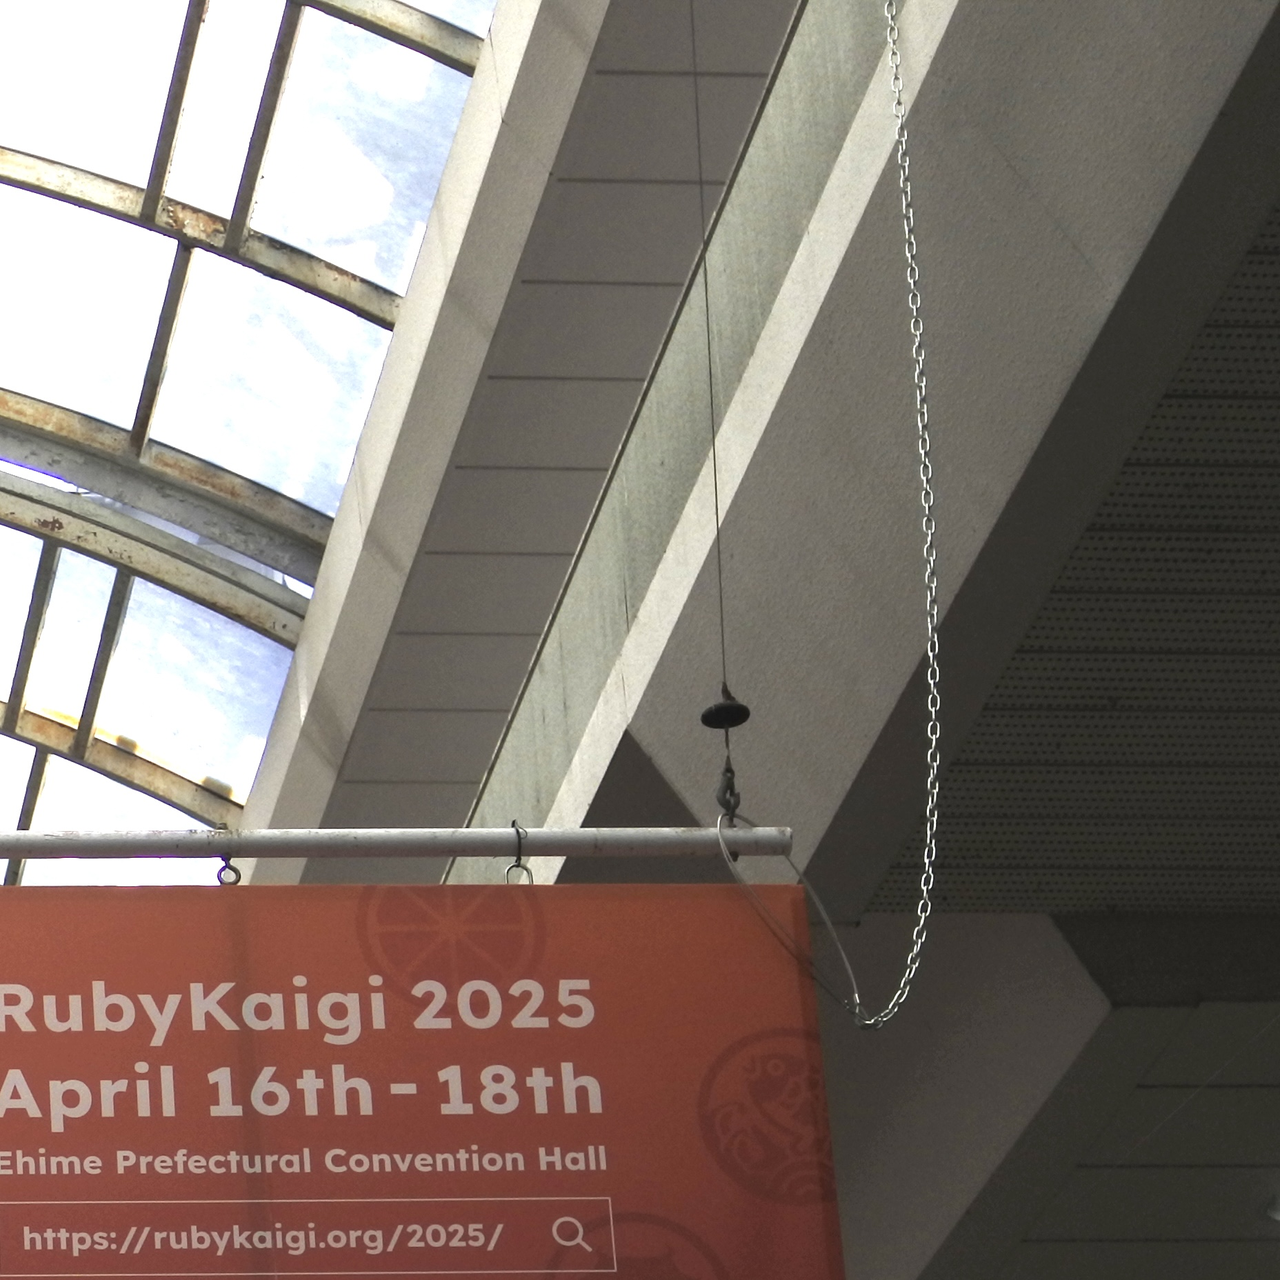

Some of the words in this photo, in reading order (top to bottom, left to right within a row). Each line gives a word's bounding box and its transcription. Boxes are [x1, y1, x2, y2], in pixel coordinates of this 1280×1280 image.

[410, 978, 595, 1030] 2025
[207, 1063, 373, 1117] 16th
[437, 1061, 603, 1115] 18th
[116, 1147, 311, 1175] Prefectural
[324, 1144, 525, 1173] Convention
[538, 1145, 607, 1171] Hall
[23, 1222, 504, 1257] https://rubykaigi.org/2025/
